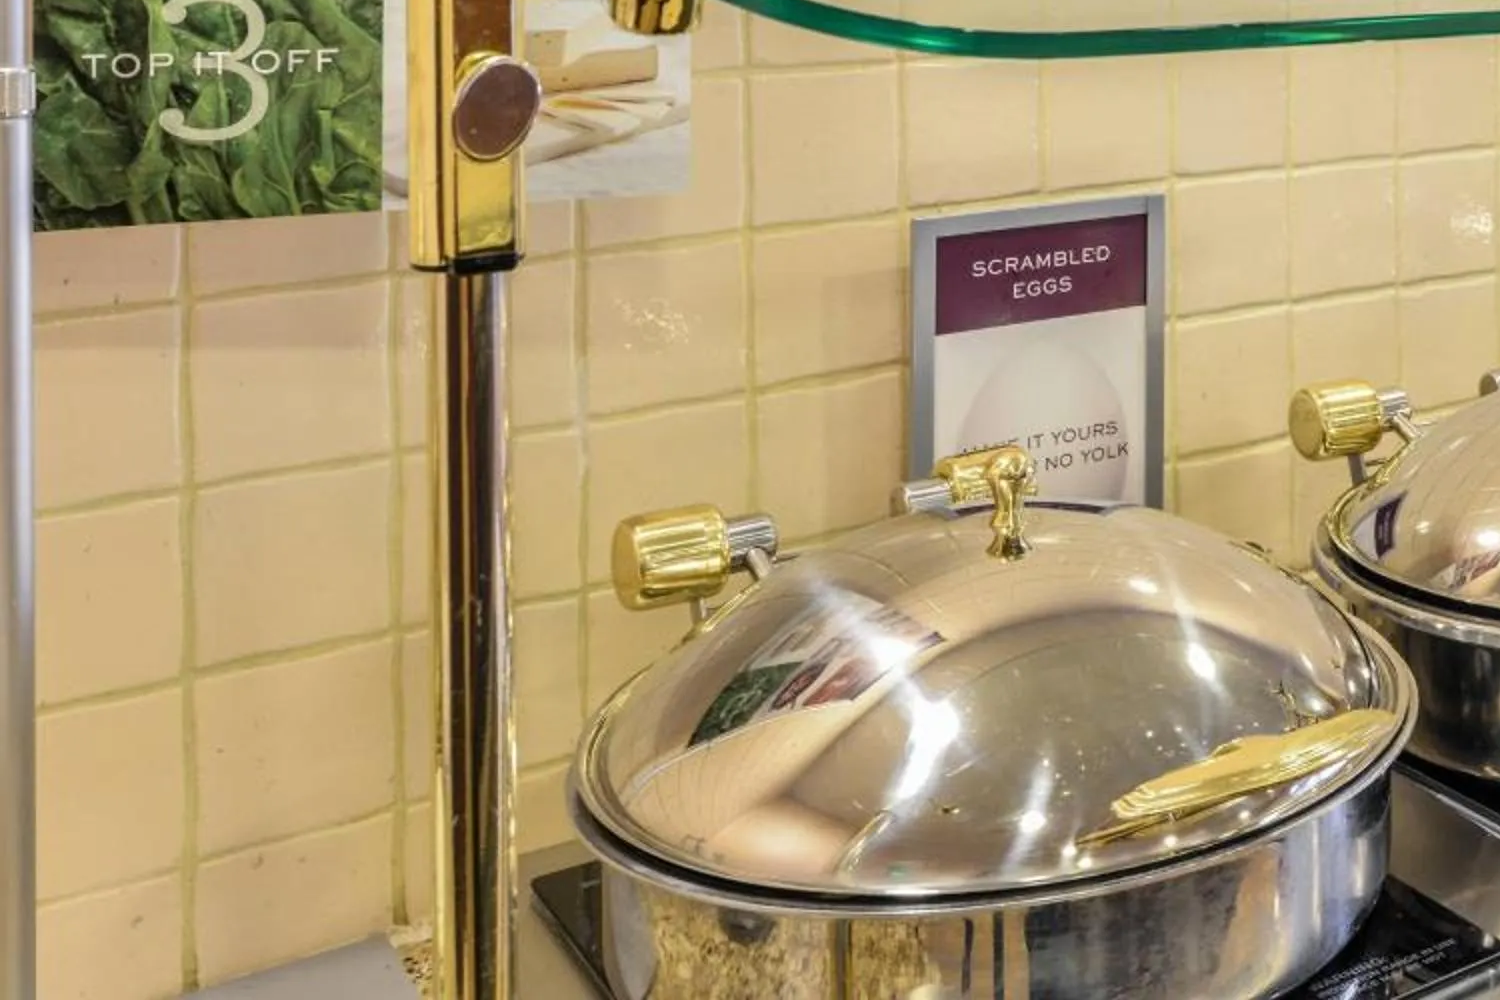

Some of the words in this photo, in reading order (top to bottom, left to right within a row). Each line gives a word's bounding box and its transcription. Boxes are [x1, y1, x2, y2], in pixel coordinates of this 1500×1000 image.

[82, 50, 174, 80] TOP
[192, 50, 230, 76] IT
[250, 48, 340, 75] OFF
[971, 244, 1111, 278] SCRAMBLED
[1012, 275, 1073, 300] EGGS
[1026, 433, 1045, 449] IT
[1050, 420, 1119, 446] YOURS
[1044, 452, 1074, 472] NO
[1080, 441, 1130, 465] YOLK
